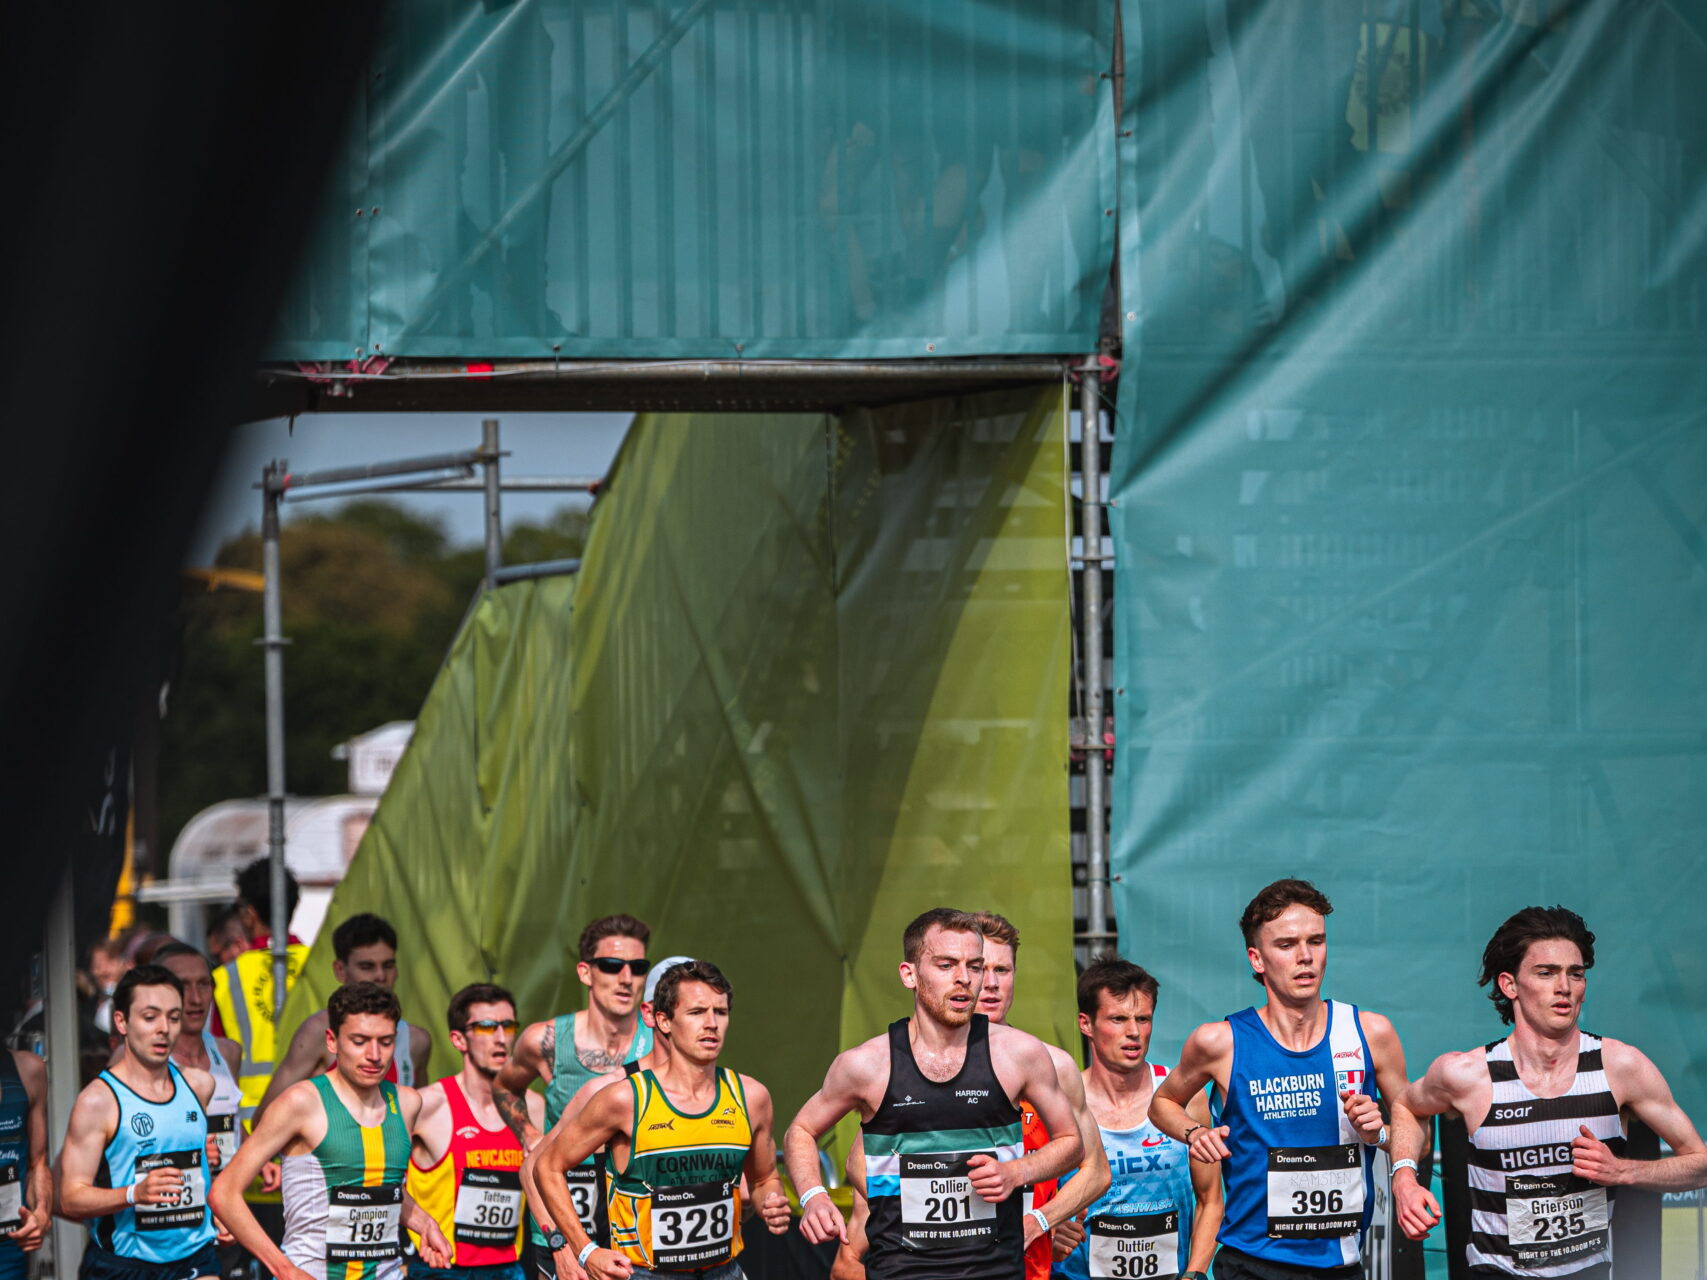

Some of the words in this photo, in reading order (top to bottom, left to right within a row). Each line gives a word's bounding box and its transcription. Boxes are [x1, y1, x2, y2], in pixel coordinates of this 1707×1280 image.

[1249, 1073, 1325, 1096] BLACKBURN
[1256, 1091, 1322, 1112] HARRIERS
[1263, 1110, 1297, 1120] ATHLETIC
[1298, 1108, 1317, 1117] CLUB
[1495, 1106, 1533, 1120] soar
[1304, 1155, 1317, 1163] On.
[1500, 1146, 1574, 1169] HIGHG
[930, 1180, 968, 1194] Collier
[1514, 1182, 1540, 1190] Dream
[658, 1193, 682, 1201] Dream
[682, 1192, 695, 1200] On.
[1292, 1189, 1343, 1214] 396
[925, 1195, 971, 1221] 201
[1532, 1197, 1583, 1214] Grierson
[350, 1208, 388, 1222] Campion
[474, 1204, 513, 1226] 360
[659, 1203, 729, 1246] 328
[1098, 1221, 1122, 1230] Dream
[1275, 1223, 1295, 1231] NIGHT
[1296, 1223, 1303, 1231] OF
[1533, 1212, 1586, 1241] 235
[349, 1223, 384, 1241] 193
[909, 1231, 928, 1239] NIGHT
[1117, 1239, 1155, 1252] Outtier
[659, 1255, 677, 1263] NIGHT
[678, 1254, 686, 1262] OF
[687, 1253, 698, 1261] THE
[1518, 1251, 1539, 1260] NIGHT
[1550, 1248, 1562, 1257] THE
[1112, 1253, 1158, 1278] 308
